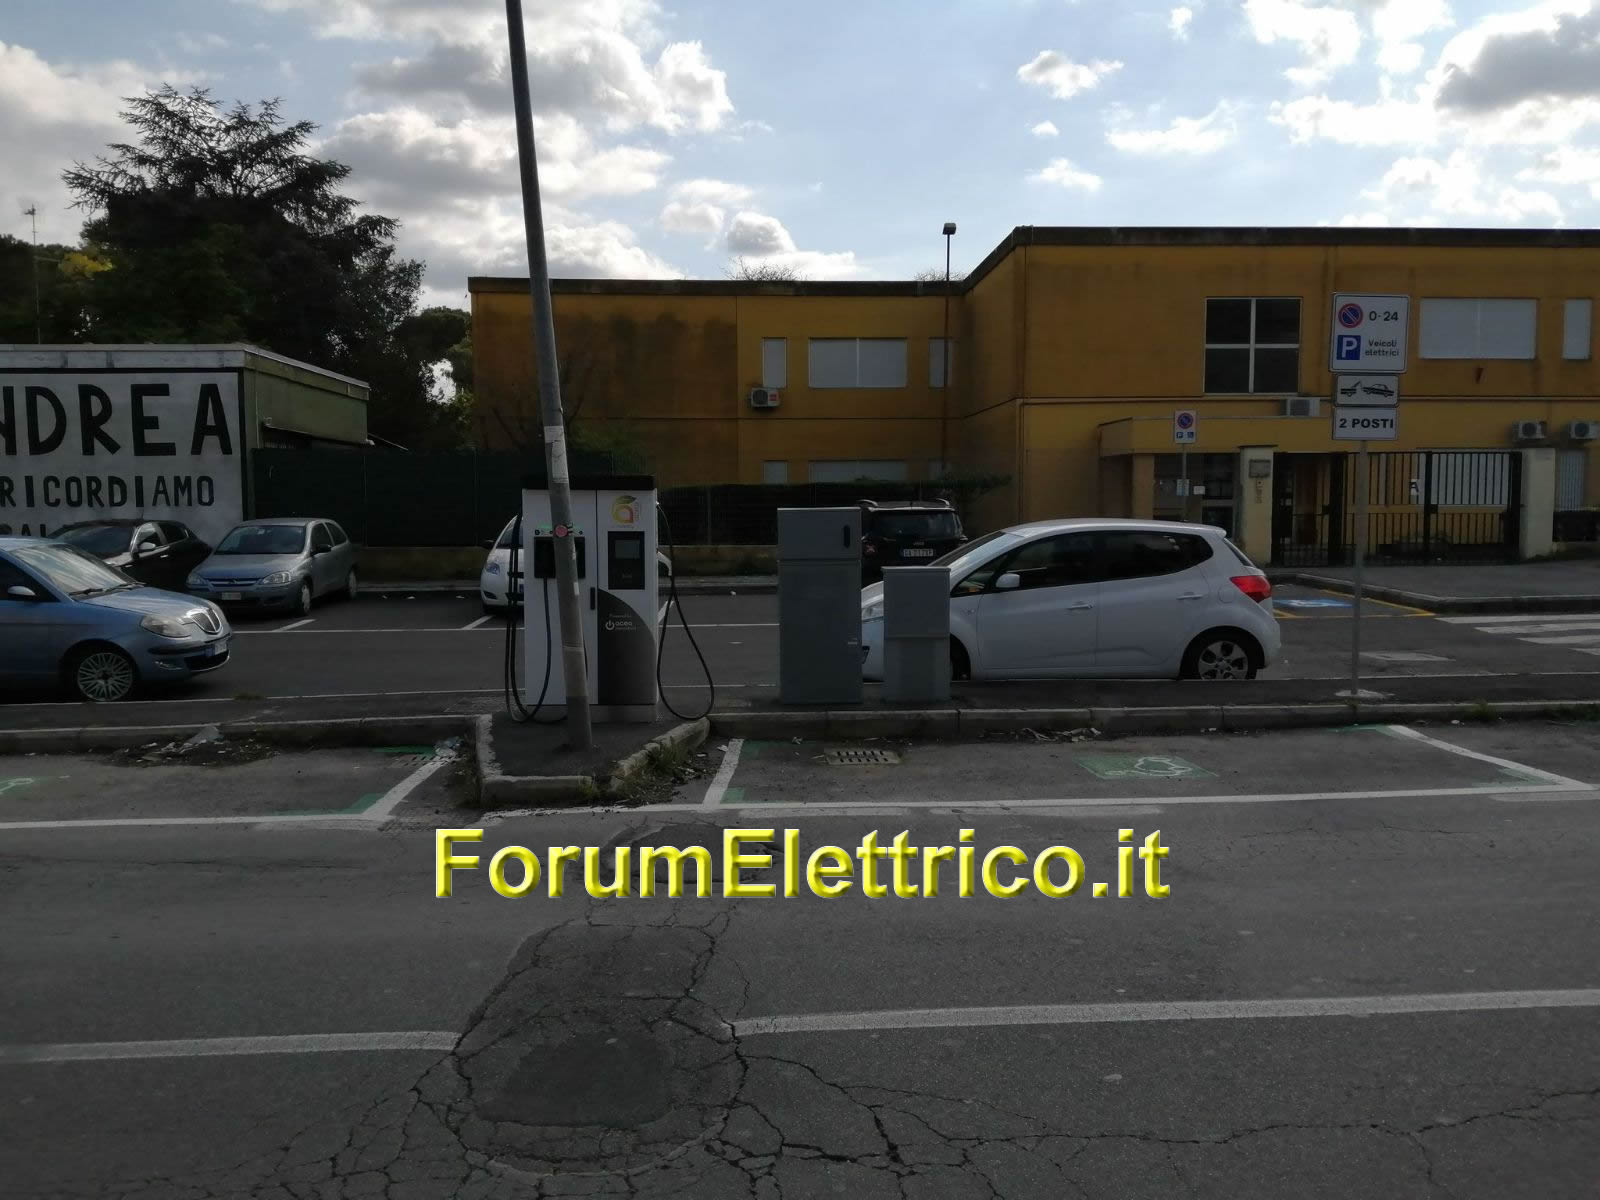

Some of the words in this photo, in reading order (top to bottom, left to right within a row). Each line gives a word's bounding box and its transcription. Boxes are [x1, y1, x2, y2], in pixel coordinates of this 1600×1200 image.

[1342, 336, 1358, 358] P
[1368, 339, 1397, 348] Veicoli
[1365, 348, 1399, 357] elettrici
[1339, 418, 1347, 428] 2
[1351, 418, 1394, 429] POSTI
